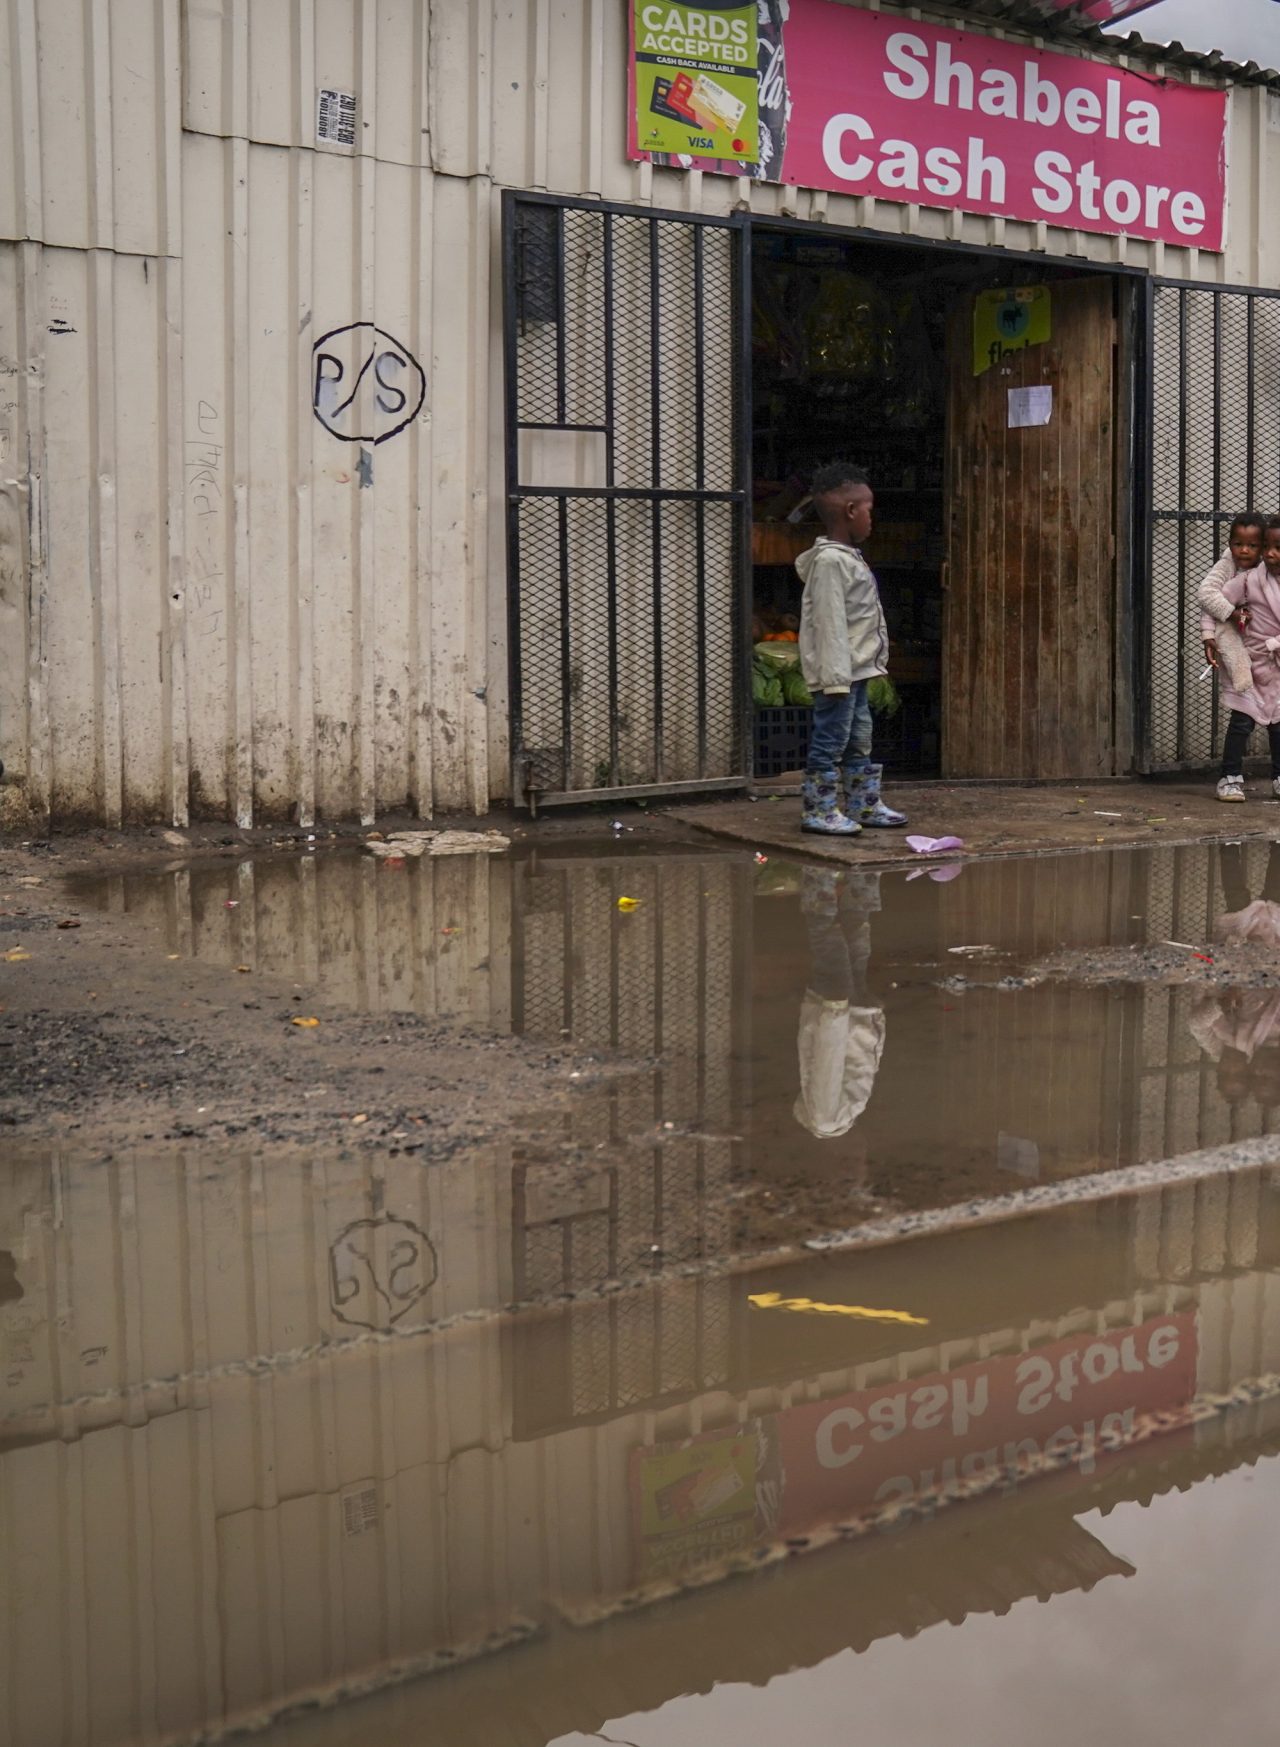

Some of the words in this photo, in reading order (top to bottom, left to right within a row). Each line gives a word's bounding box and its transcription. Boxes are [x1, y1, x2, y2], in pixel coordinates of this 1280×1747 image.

[642, 5, 748, 44] CARDS
[642, 33, 748, 63] ACCEPTED
[656, 56, 678, 66] CASH
[678, 58, 698, 68] BACK
[698, 62, 736, 74] AVAILABLE
[882, 31, 1162, 149] Shabela
[318, 97, 329, 138] ABORTION
[687, 136, 714, 149] VISA
[821, 112, 1007, 205] Cash
[1031, 149, 1207, 237] Store
